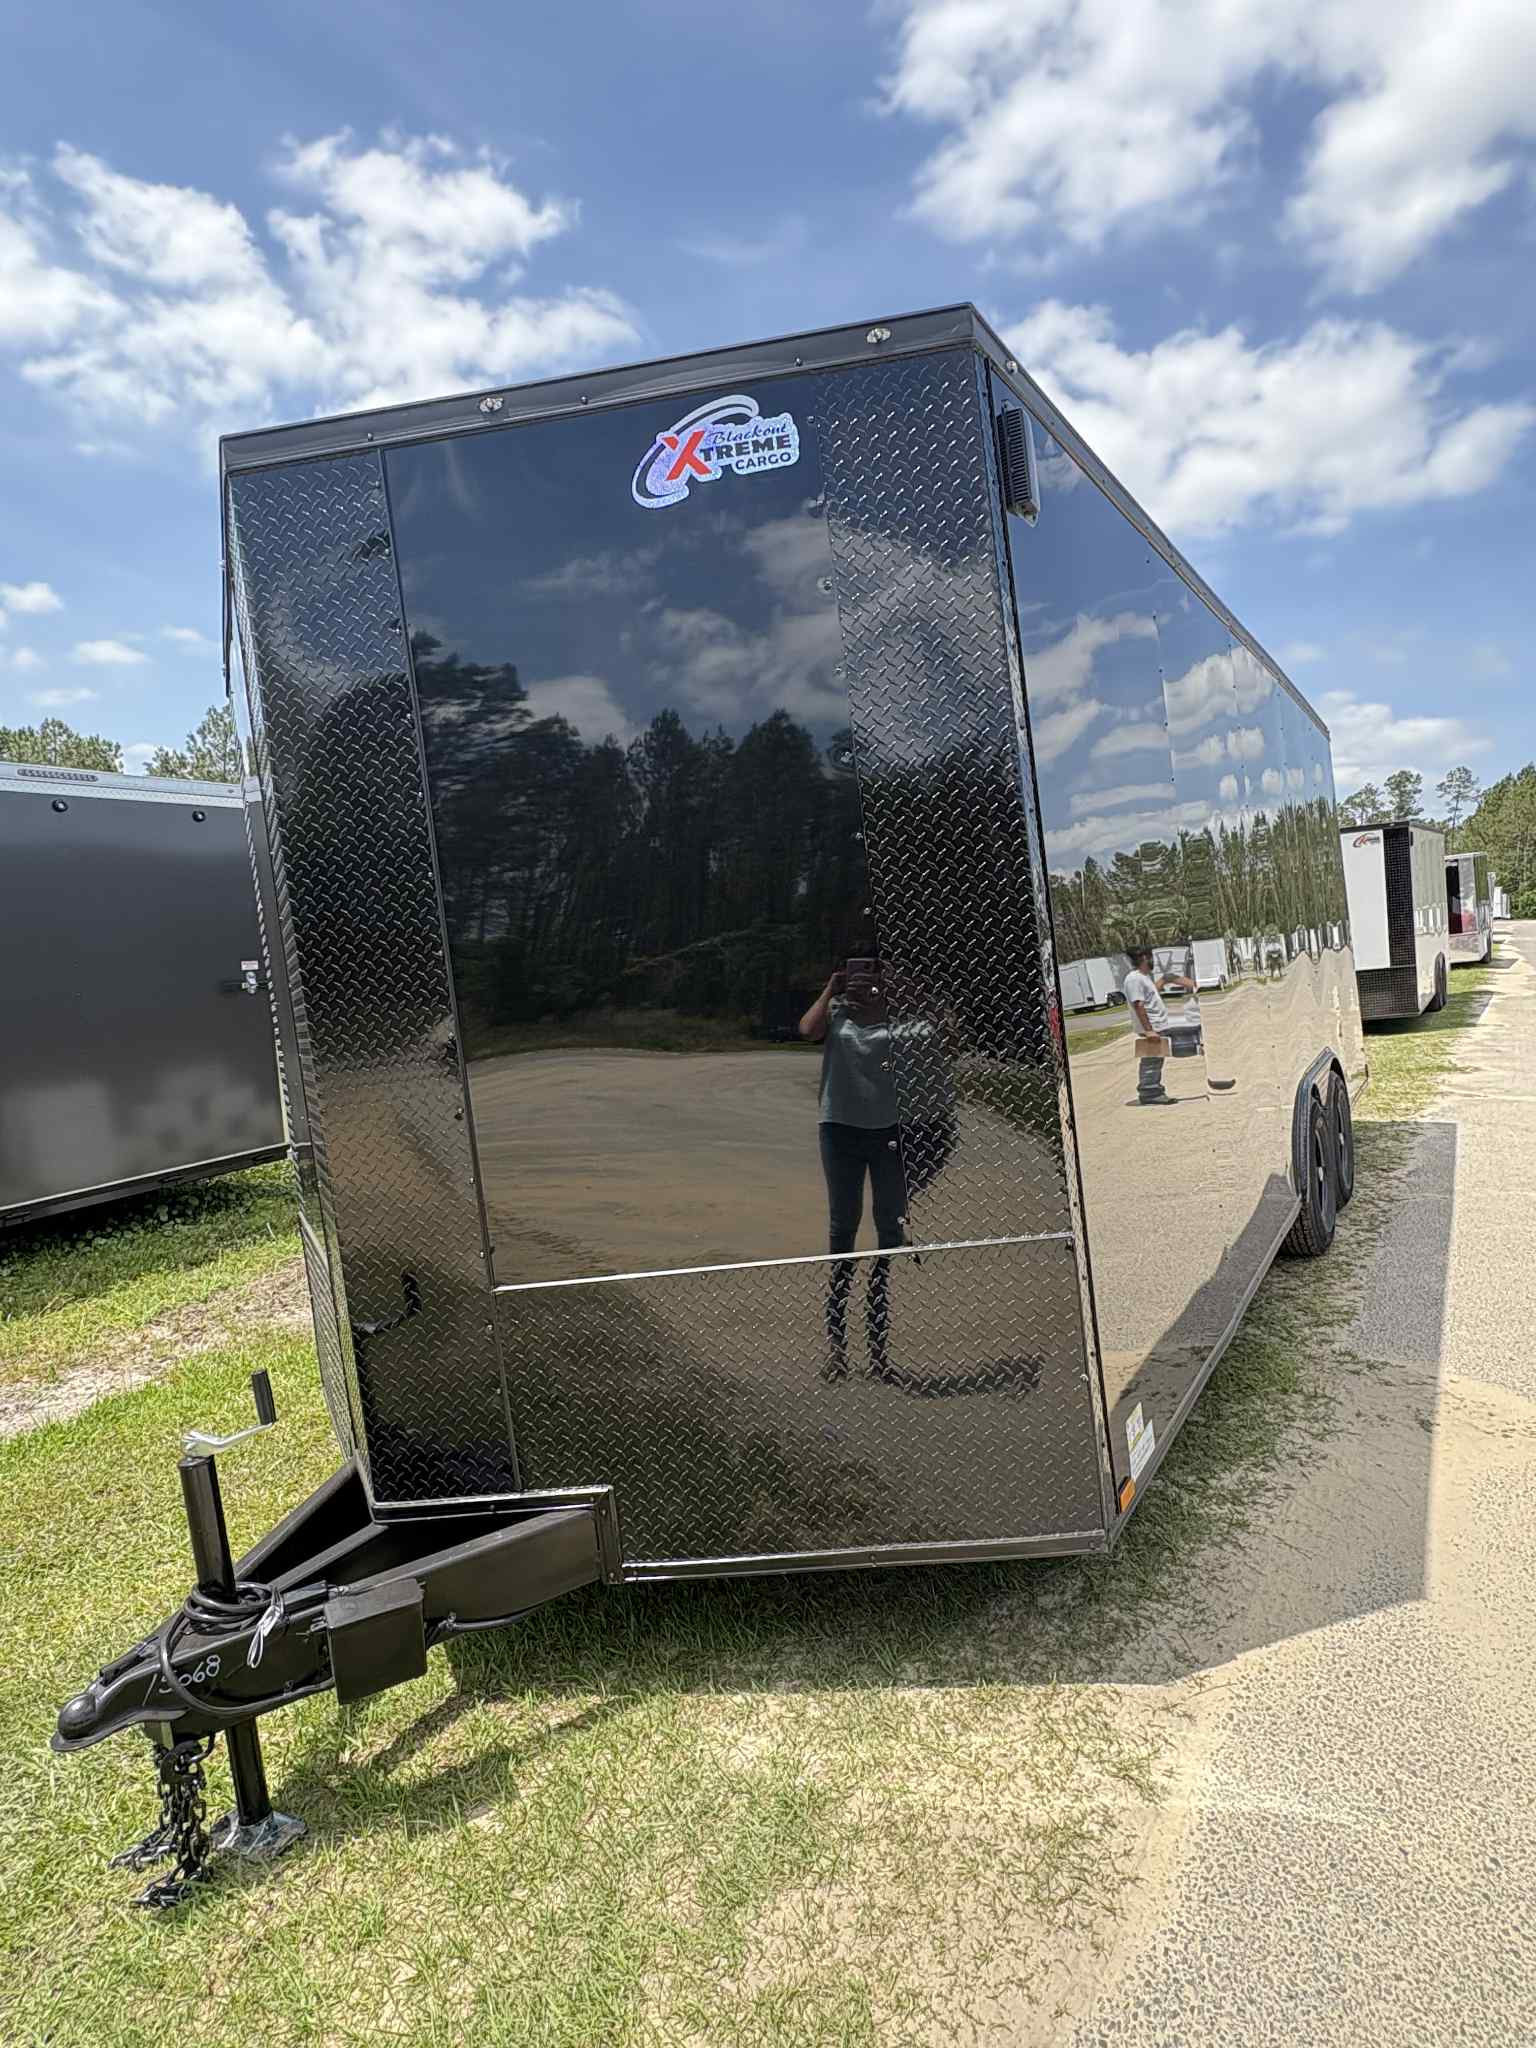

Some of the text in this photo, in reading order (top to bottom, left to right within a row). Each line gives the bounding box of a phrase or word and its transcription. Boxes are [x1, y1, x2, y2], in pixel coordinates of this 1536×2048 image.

[708, 423, 787, 445] Blackout
[661, 430, 792, 481] XTREME
[735, 451, 792, 470] CARGO
